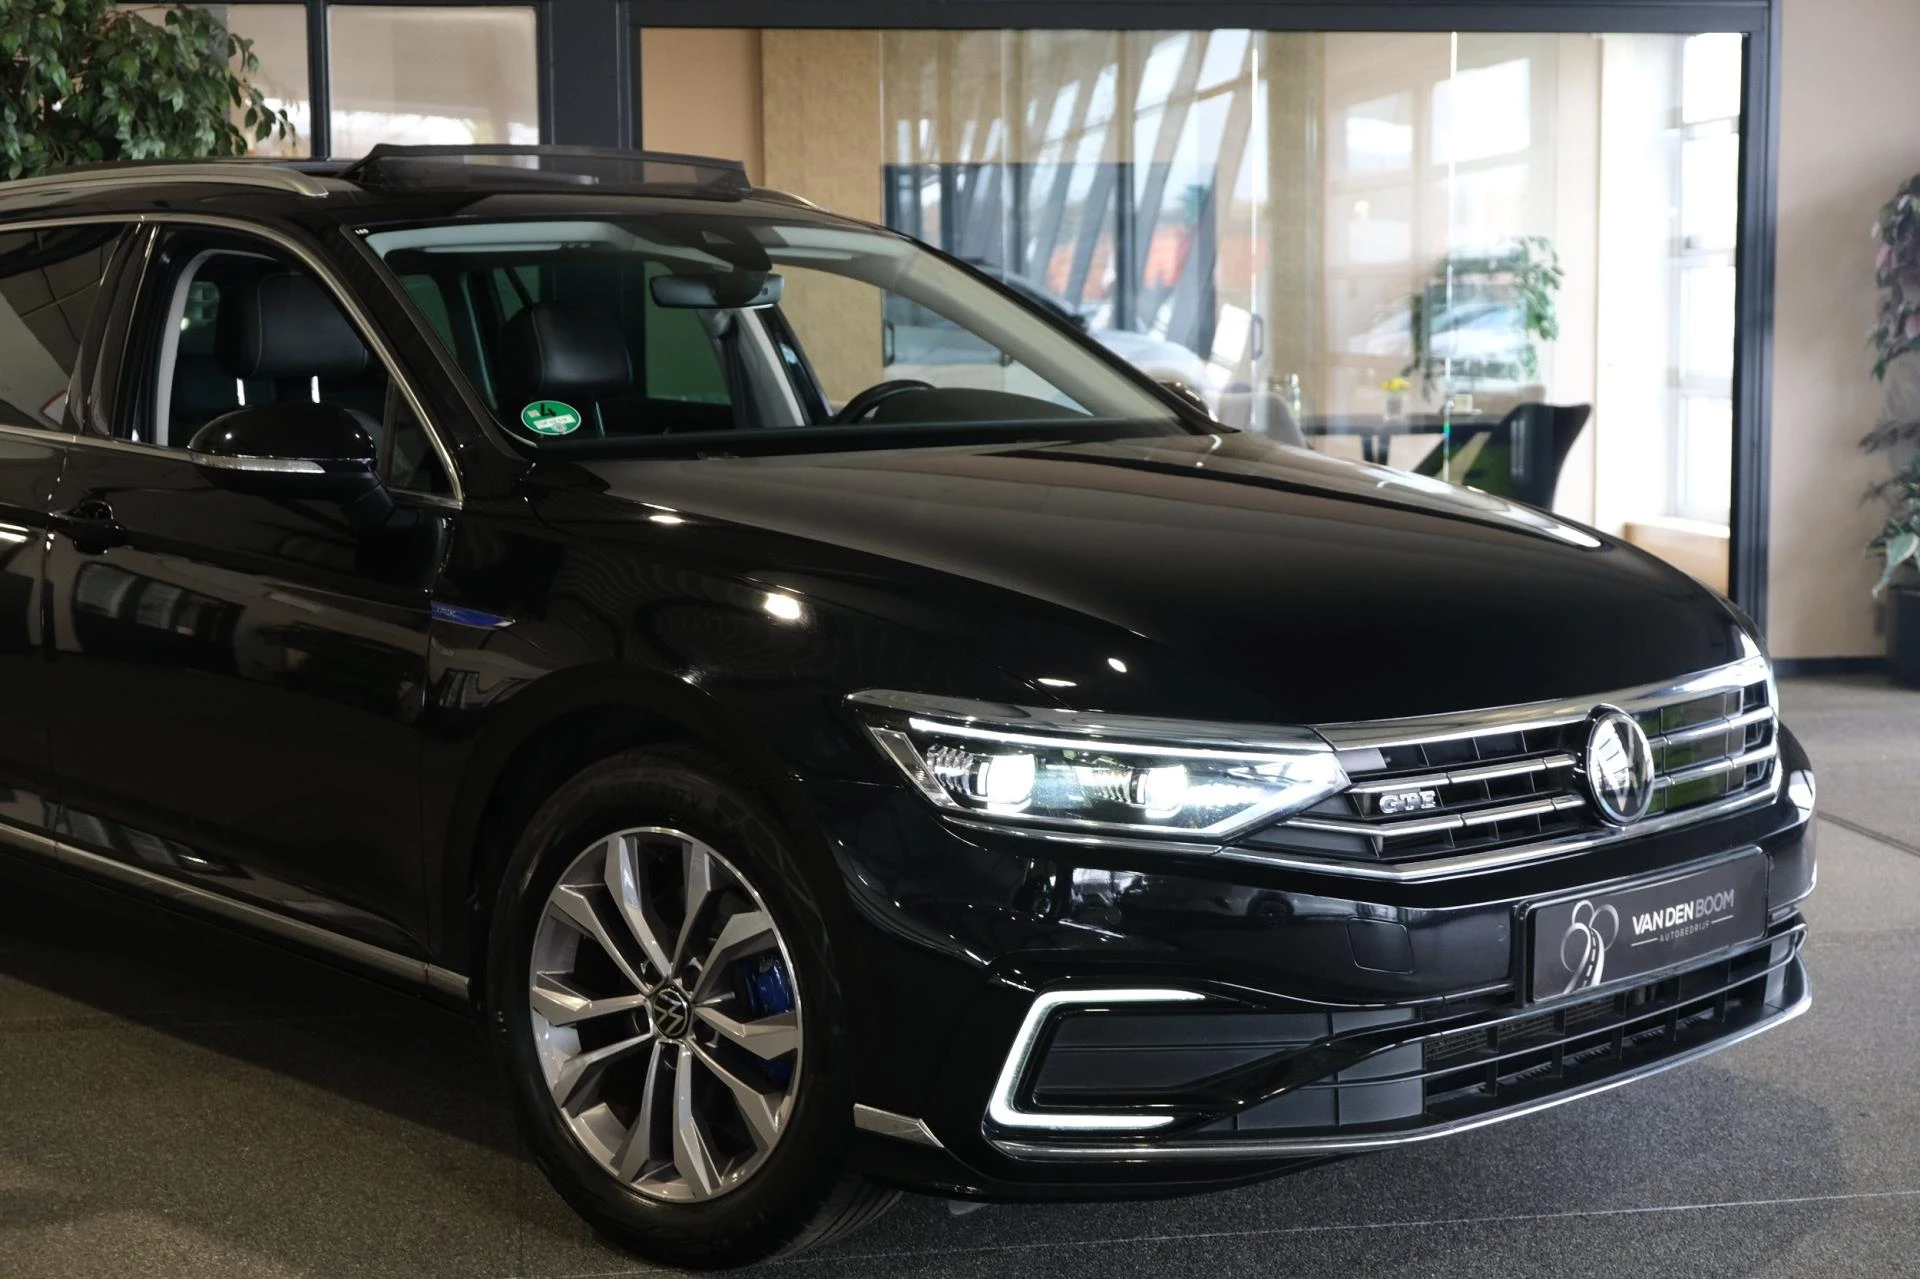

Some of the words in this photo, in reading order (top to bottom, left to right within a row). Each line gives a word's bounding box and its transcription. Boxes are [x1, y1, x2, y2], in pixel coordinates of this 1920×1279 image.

[1379, 790, 1436, 814] GTE
[1632, 910, 1663, 935] VAN
[1665, 901, 1694, 927] DEN
[1695, 889, 1735, 918] BOOM
[1659, 920, 1710, 942] AUTOBEDRIJF
